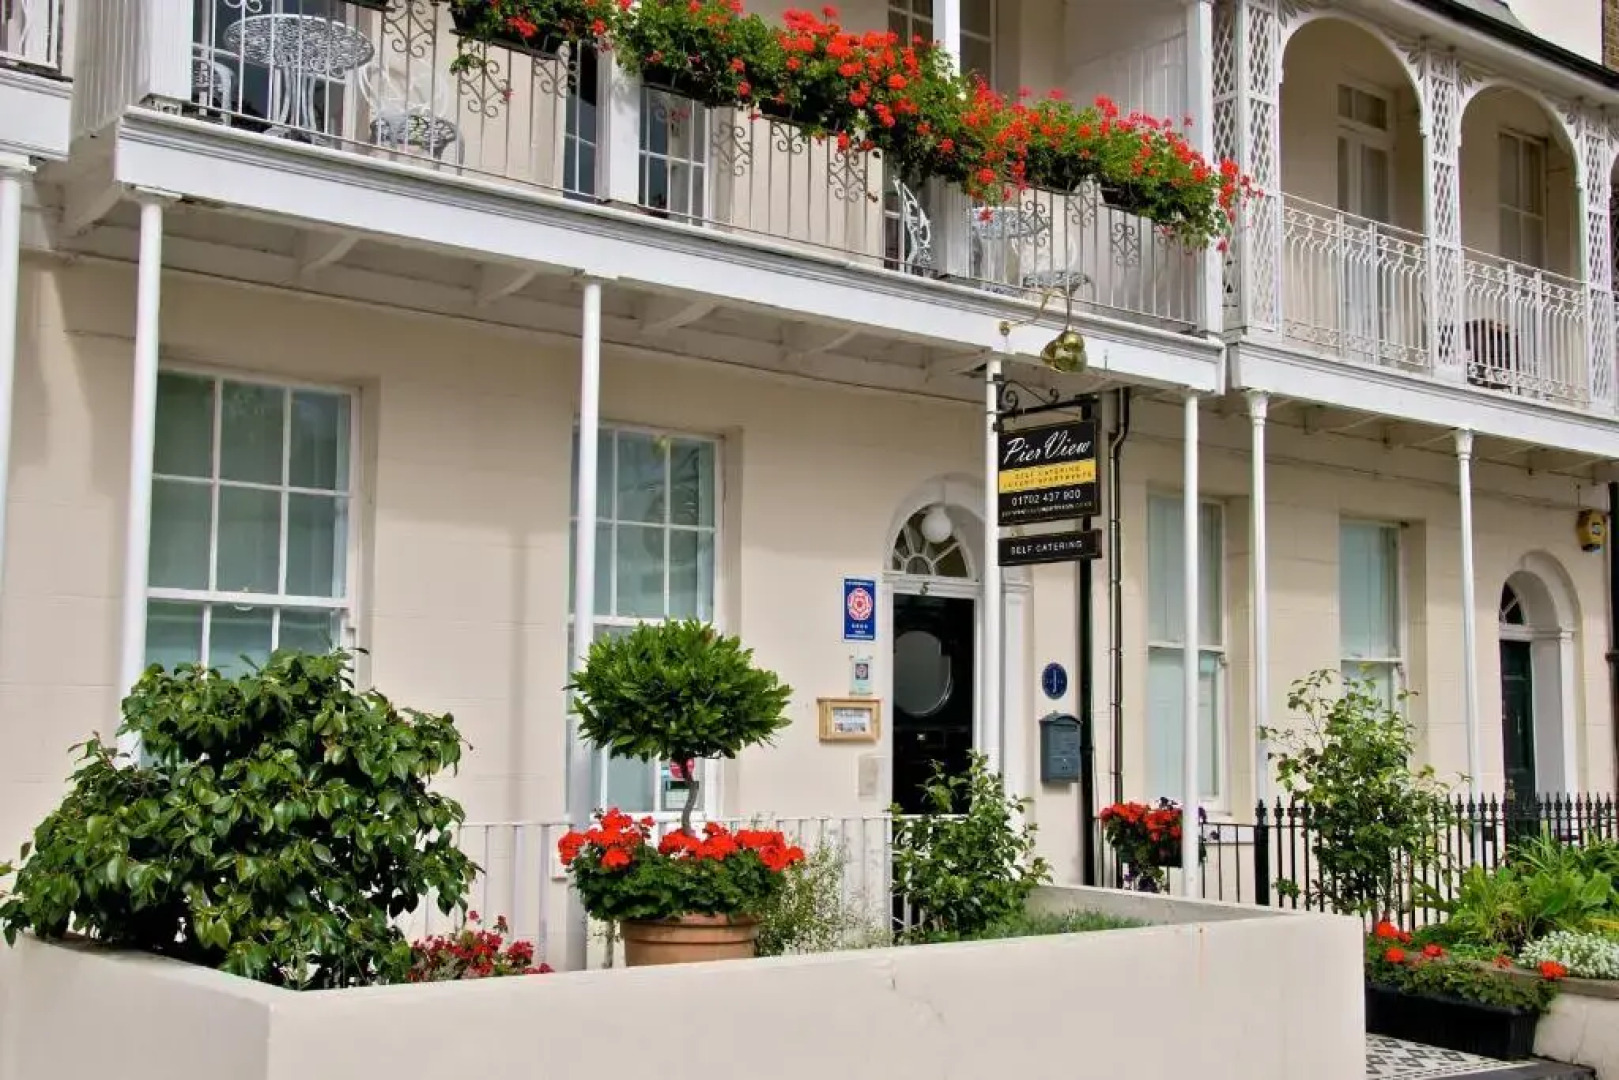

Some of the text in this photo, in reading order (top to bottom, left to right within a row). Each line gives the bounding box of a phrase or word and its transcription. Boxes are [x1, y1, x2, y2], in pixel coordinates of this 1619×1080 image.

[1003, 429, 1092, 465] Pier View
[1011, 494, 1040, 506] 01702
[1011, 540, 1083, 556] SELF CATERING
